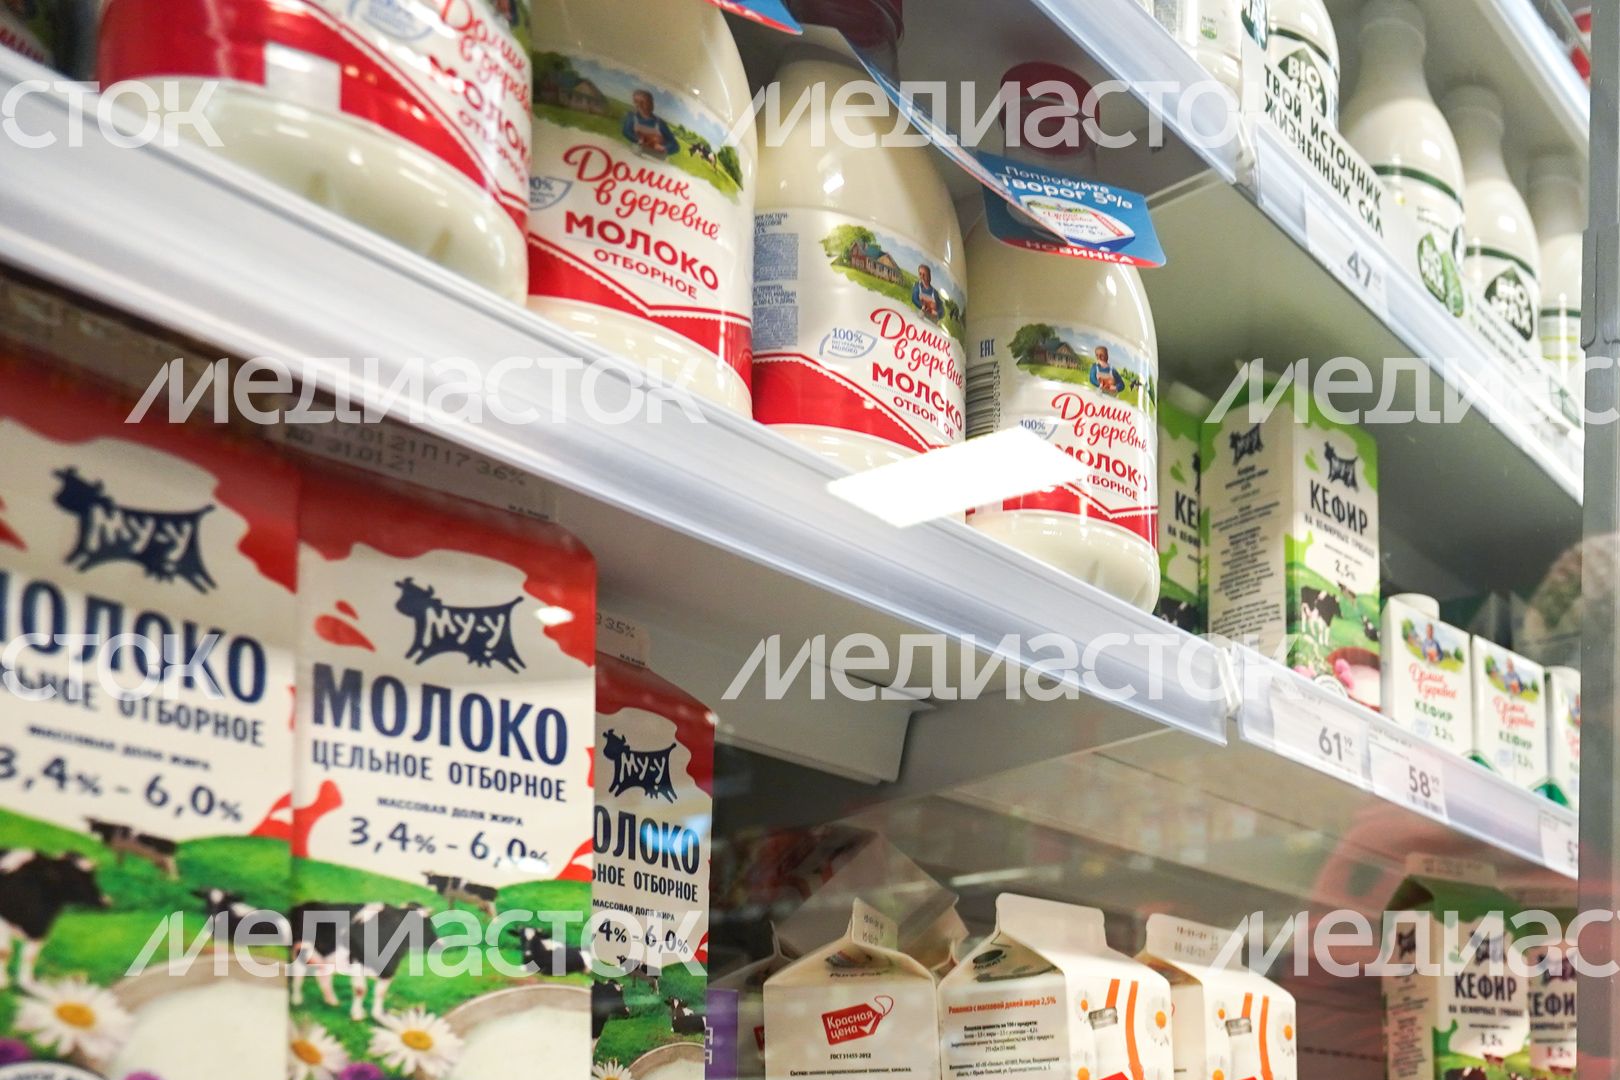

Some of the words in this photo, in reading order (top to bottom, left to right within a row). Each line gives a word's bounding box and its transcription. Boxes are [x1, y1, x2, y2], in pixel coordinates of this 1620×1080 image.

[1287, 55, 1322, 88] BIO
[1263, 63, 1302, 124] ТВОЙ
[1310, 116, 1382, 211] ИСТОЧНИК
[563, 144, 690, 200] Домик
[1004, 165, 1110, 194] Попробуйте
[1264, 92, 1351, 204] ЖИЗНЕННЫХ
[1358, 199, 1384, 238] СИЛ
[595, 178, 612, 205] в
[615, 187, 721, 241] деревне
[564, 211, 719, 291] МОЛОКО
[1025, 239, 1134, 265] НОВИНКА
[594, 249, 698, 300] ОТБОРНОЕ
[1347, 250, 1372, 288] 47
[831, 327, 866, 345] 100%
[870, 308, 951, 357] Домик
[1051, 392, 1132, 425] Домик
[1086, 473, 1138, 502] БОРНОЕ
[1310, 479, 1368, 536] КЕФИР
[118, 690, 265, 748] ОТБОРНОЕ
[311, 661, 569, 767] МОЛОКО
[1414, 699, 1453, 722] КЕФИР
[1318, 725, 1343, 761] 61
[311, 738, 434, 781] ЦЕЛЬНОЕ
[447, 760, 568, 803] ОТБОРНОЕ
[1408, 764, 1431, 799] 58
[349, 815, 437, 856] 3,4%
[593, 805, 700, 876] ОЛОКО
[633, 871, 699, 903] ОТБОРНОЕ
[592, 898, 634, 914] МАССОВАЯ
[592, 917, 628, 945] ,4%
[1454, 971, 1517, 1001] КЕФИР
[1528, 991, 1576, 1016] ЕФИ
[826, 1010, 874, 1030] Красная
[830, 1024, 858, 1040] цена
